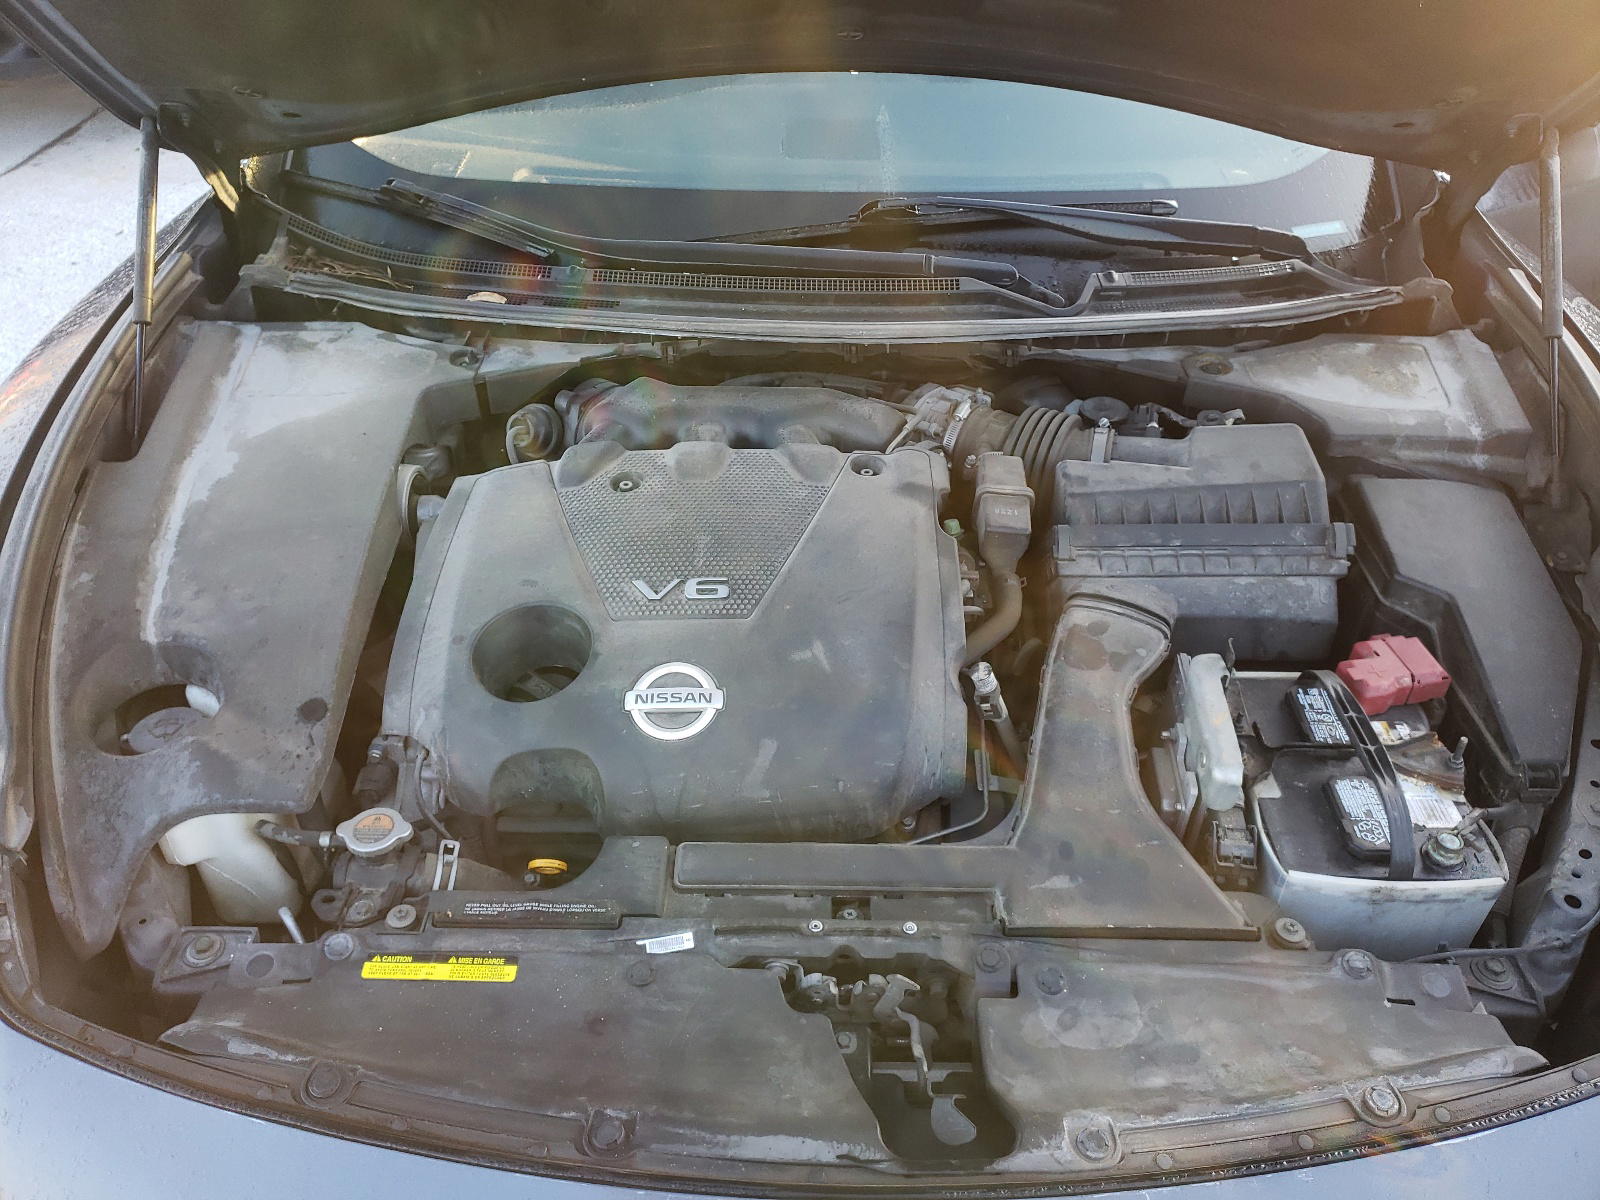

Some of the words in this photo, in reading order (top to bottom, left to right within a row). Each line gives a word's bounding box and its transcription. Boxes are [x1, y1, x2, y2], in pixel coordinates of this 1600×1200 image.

[631, 577, 731, 600] V6
[634, 692, 713, 705] NISSAN
[382, 955, 413, 963] CAUTION
